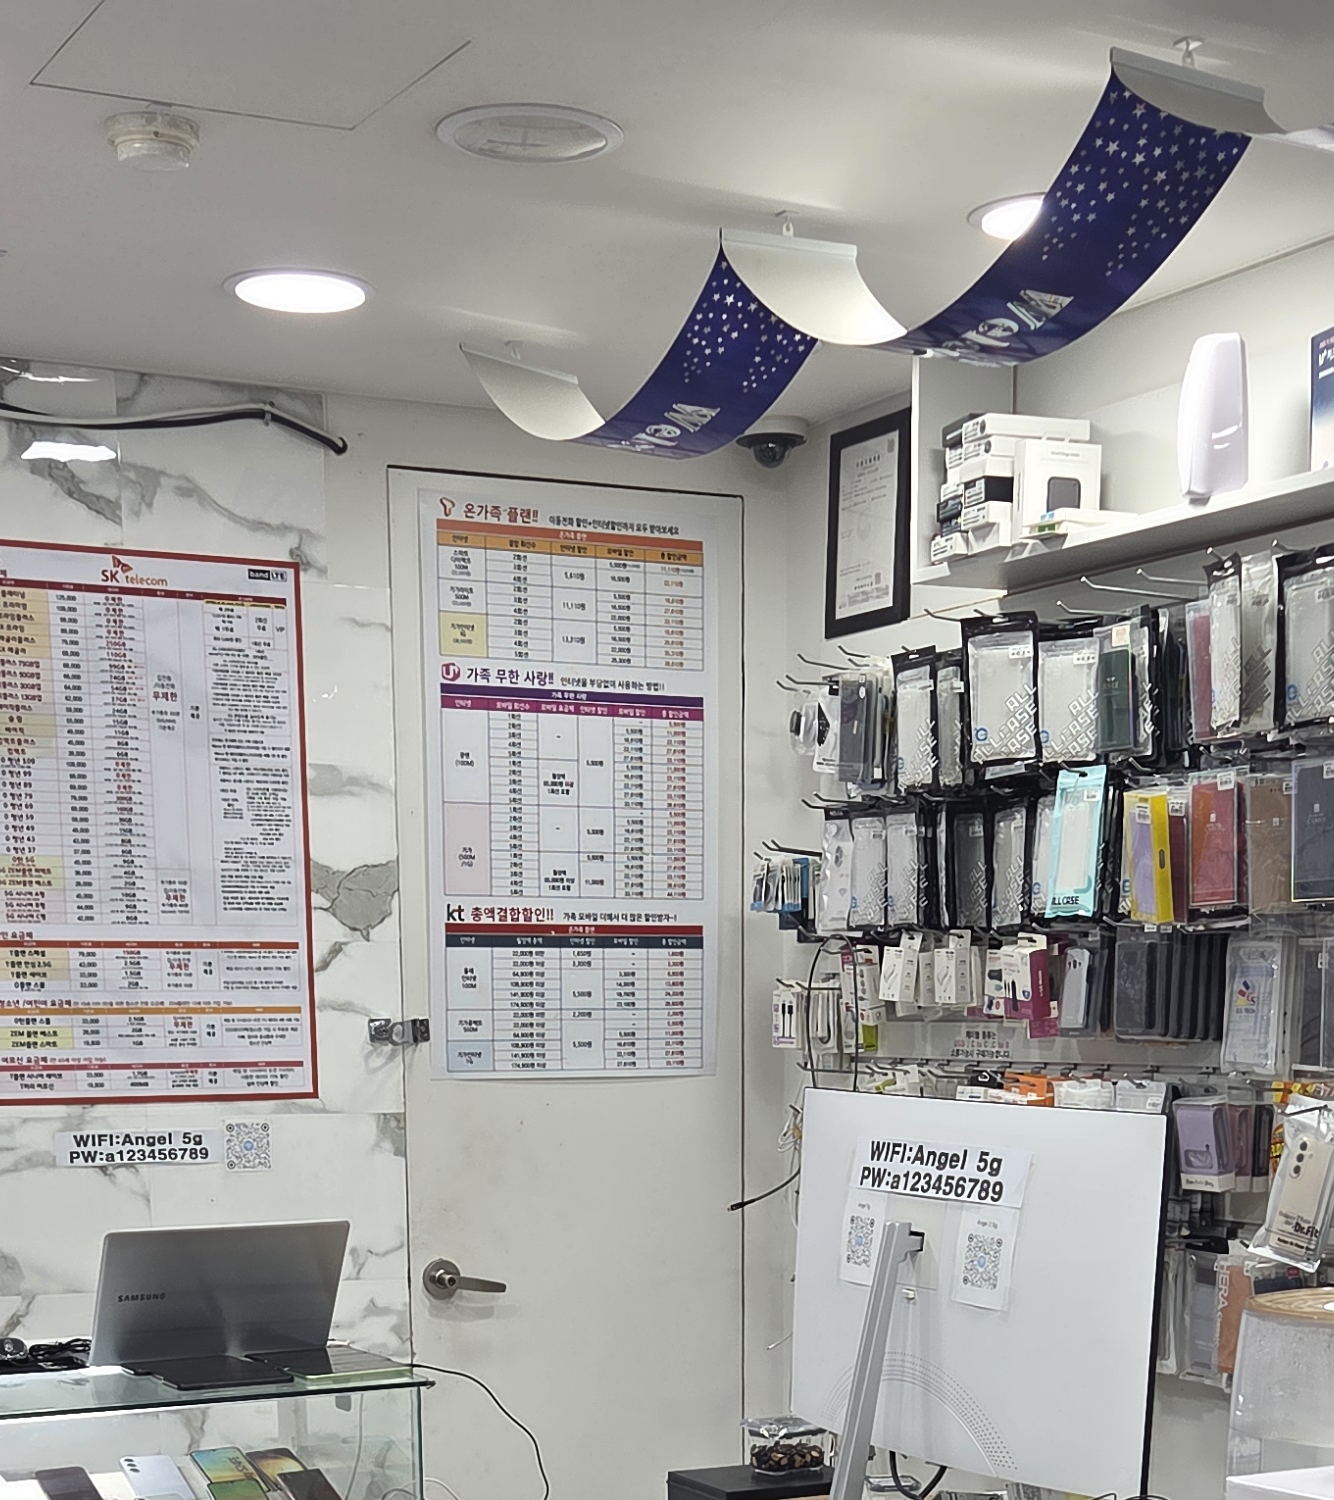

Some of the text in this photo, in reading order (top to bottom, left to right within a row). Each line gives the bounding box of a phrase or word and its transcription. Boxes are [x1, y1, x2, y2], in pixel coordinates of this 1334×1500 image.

[101, 569, 168, 587] SK telecom
[467, 667, 491, 683] 가족
[495, 669, 520, 684] 무한
[447, 904, 465, 922] kt
[73, 1132, 203, 1148] WIFI:Angel 5g
[69, 1147, 209, 1164] PW:a123456789
[870, 1141, 1003, 1177] WIFI:Angel 5g
[860, 1166, 1004, 1202] PW:a123456789
[117, 1292, 166, 1303] SAMSUNG
